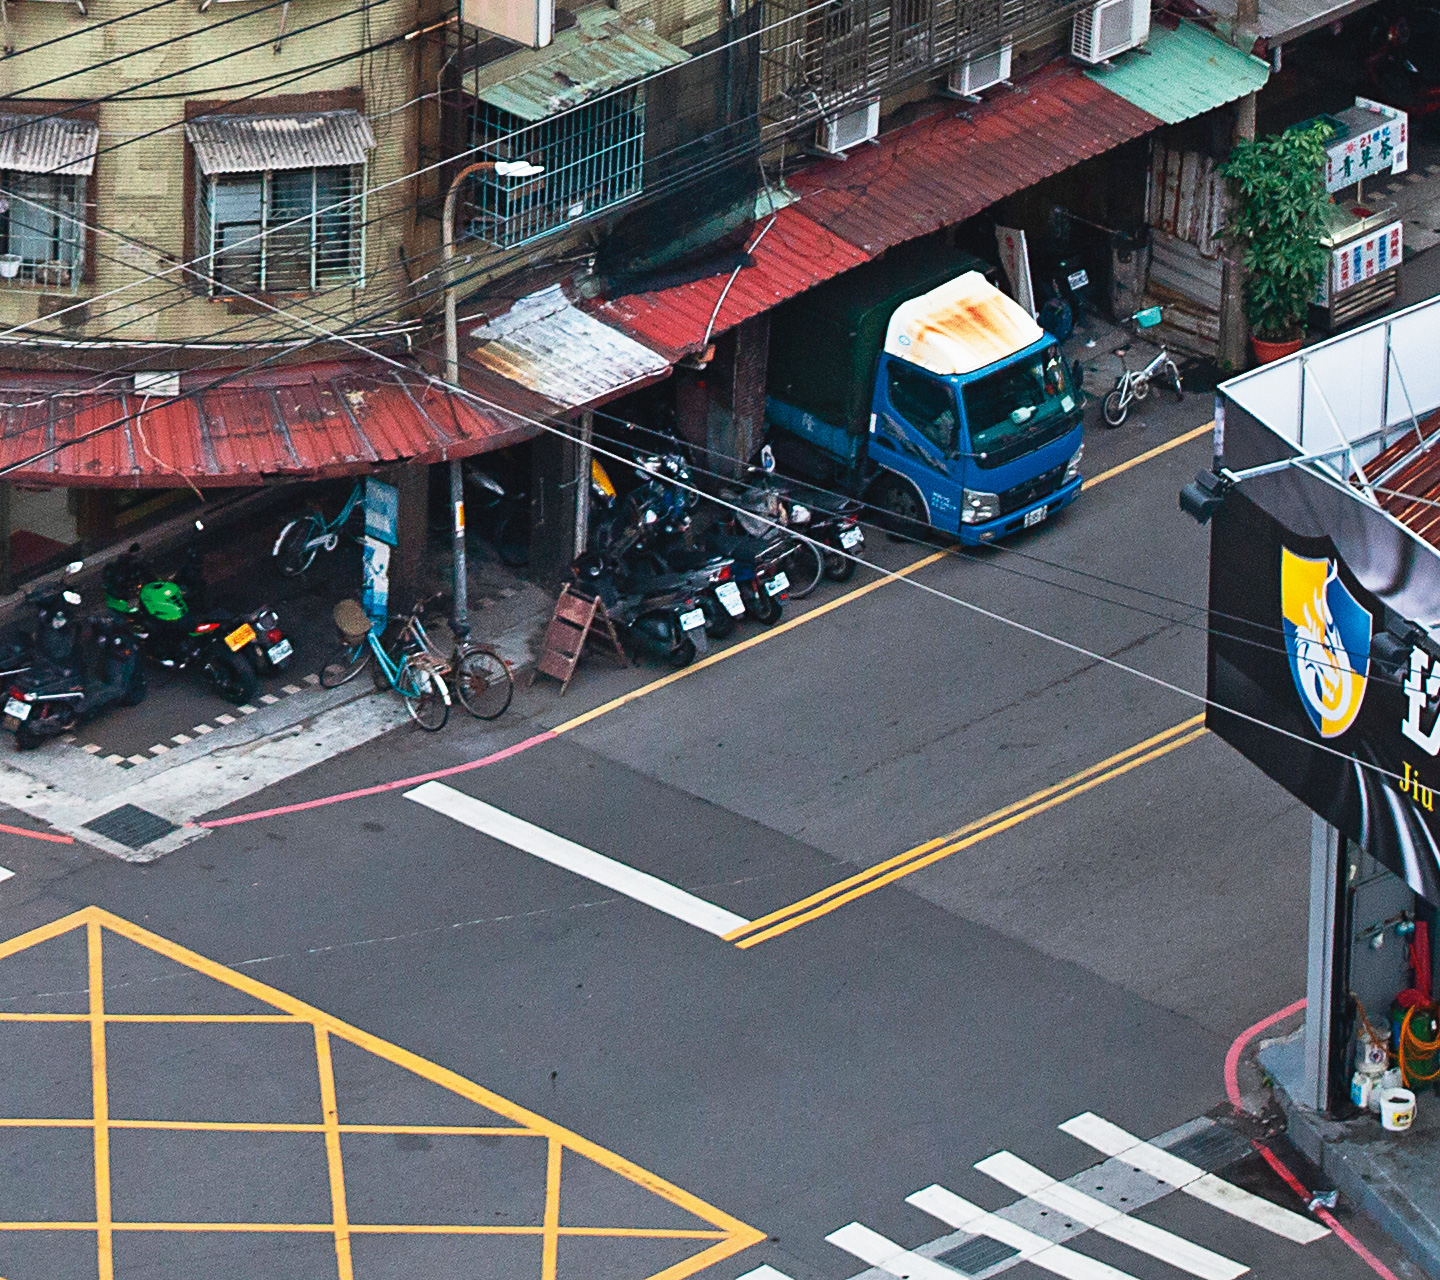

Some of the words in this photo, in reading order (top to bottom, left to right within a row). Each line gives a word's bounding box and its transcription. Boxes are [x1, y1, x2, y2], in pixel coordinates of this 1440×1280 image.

[1333, 137, 1394, 178] 青草茶
[1399, 760, 1434, 812] Jiu
